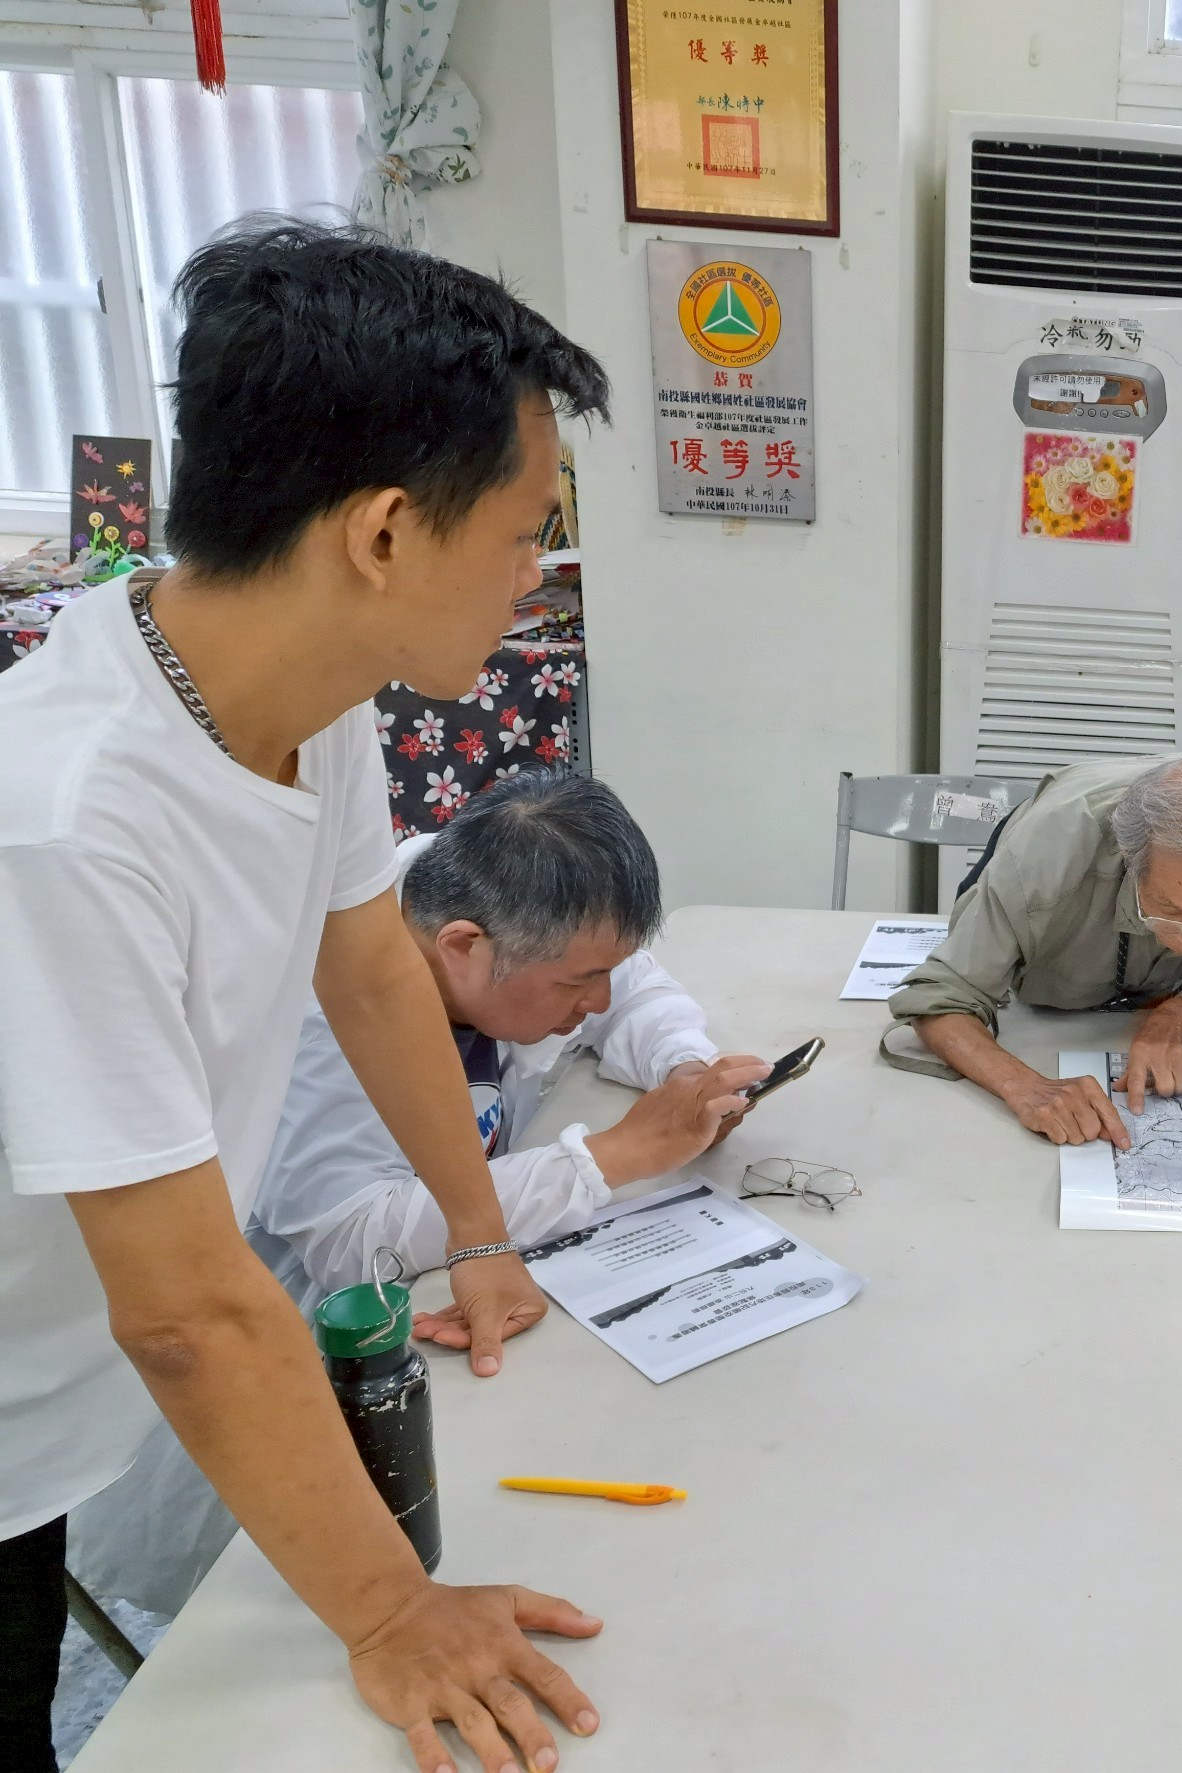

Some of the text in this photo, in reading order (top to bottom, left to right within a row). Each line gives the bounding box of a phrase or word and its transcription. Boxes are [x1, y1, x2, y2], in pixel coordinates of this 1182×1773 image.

[685, 266, 737, 301] 全國社區選拔
[689, 332, 771, 364] Exemplary Community
[713, 371, 753, 389] 恭賀
[1033, 374, 1101, 385] 未經許可請勿使用
[658, 389, 807, 411] 南投縣國姓鄉國姓社區發展協會
[695, 486, 735, 498] 南投縣長
[686, 499, 789, 515] 中華民國107年10月31日
